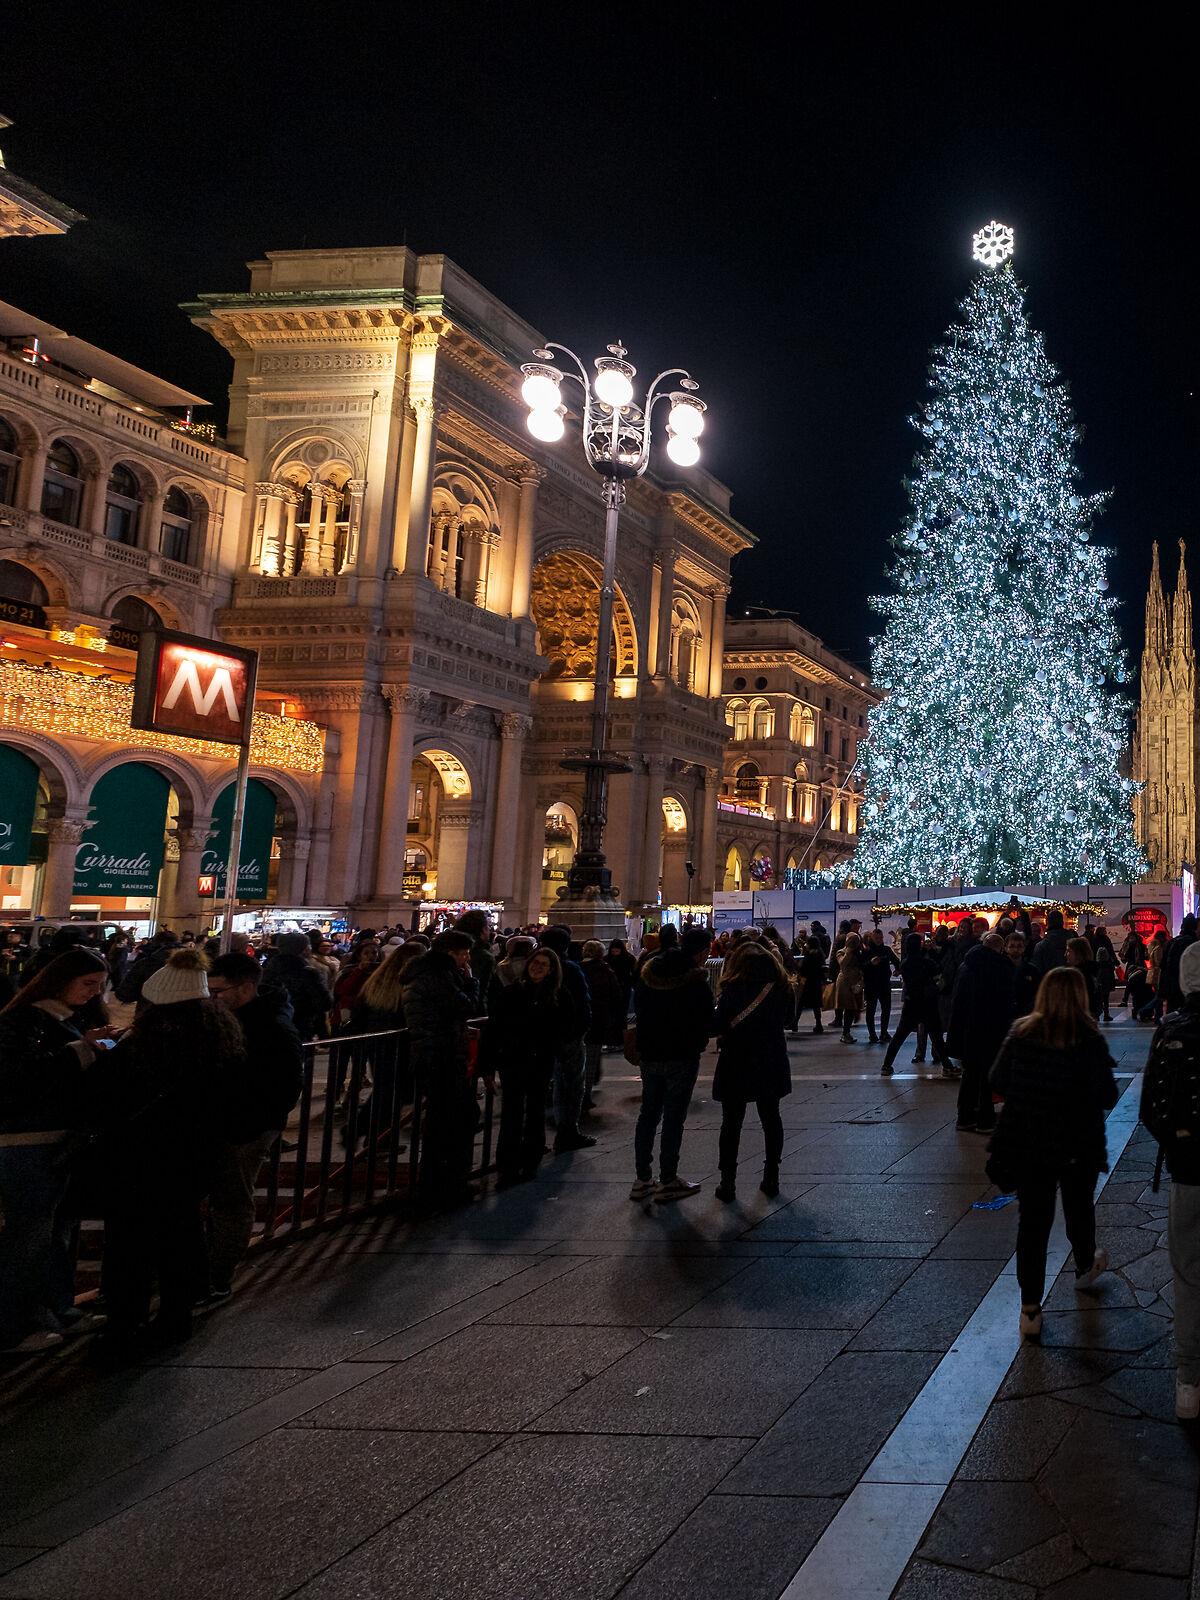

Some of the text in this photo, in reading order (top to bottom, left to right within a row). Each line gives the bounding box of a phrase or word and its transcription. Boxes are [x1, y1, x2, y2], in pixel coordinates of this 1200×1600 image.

[0, 602, 18, 615] MO
[20, 607, 35, 619] 21
[110, 629, 139, 644] OMO
[161, 659, 241, 723] M
[74, 842, 151, 873] Currado
[200, 850, 261, 877] Curdo
[103, 868, 150, 876] GIOIELLERIE
[199, 879, 214, 891] M
[402, 875, 422, 886] otta
